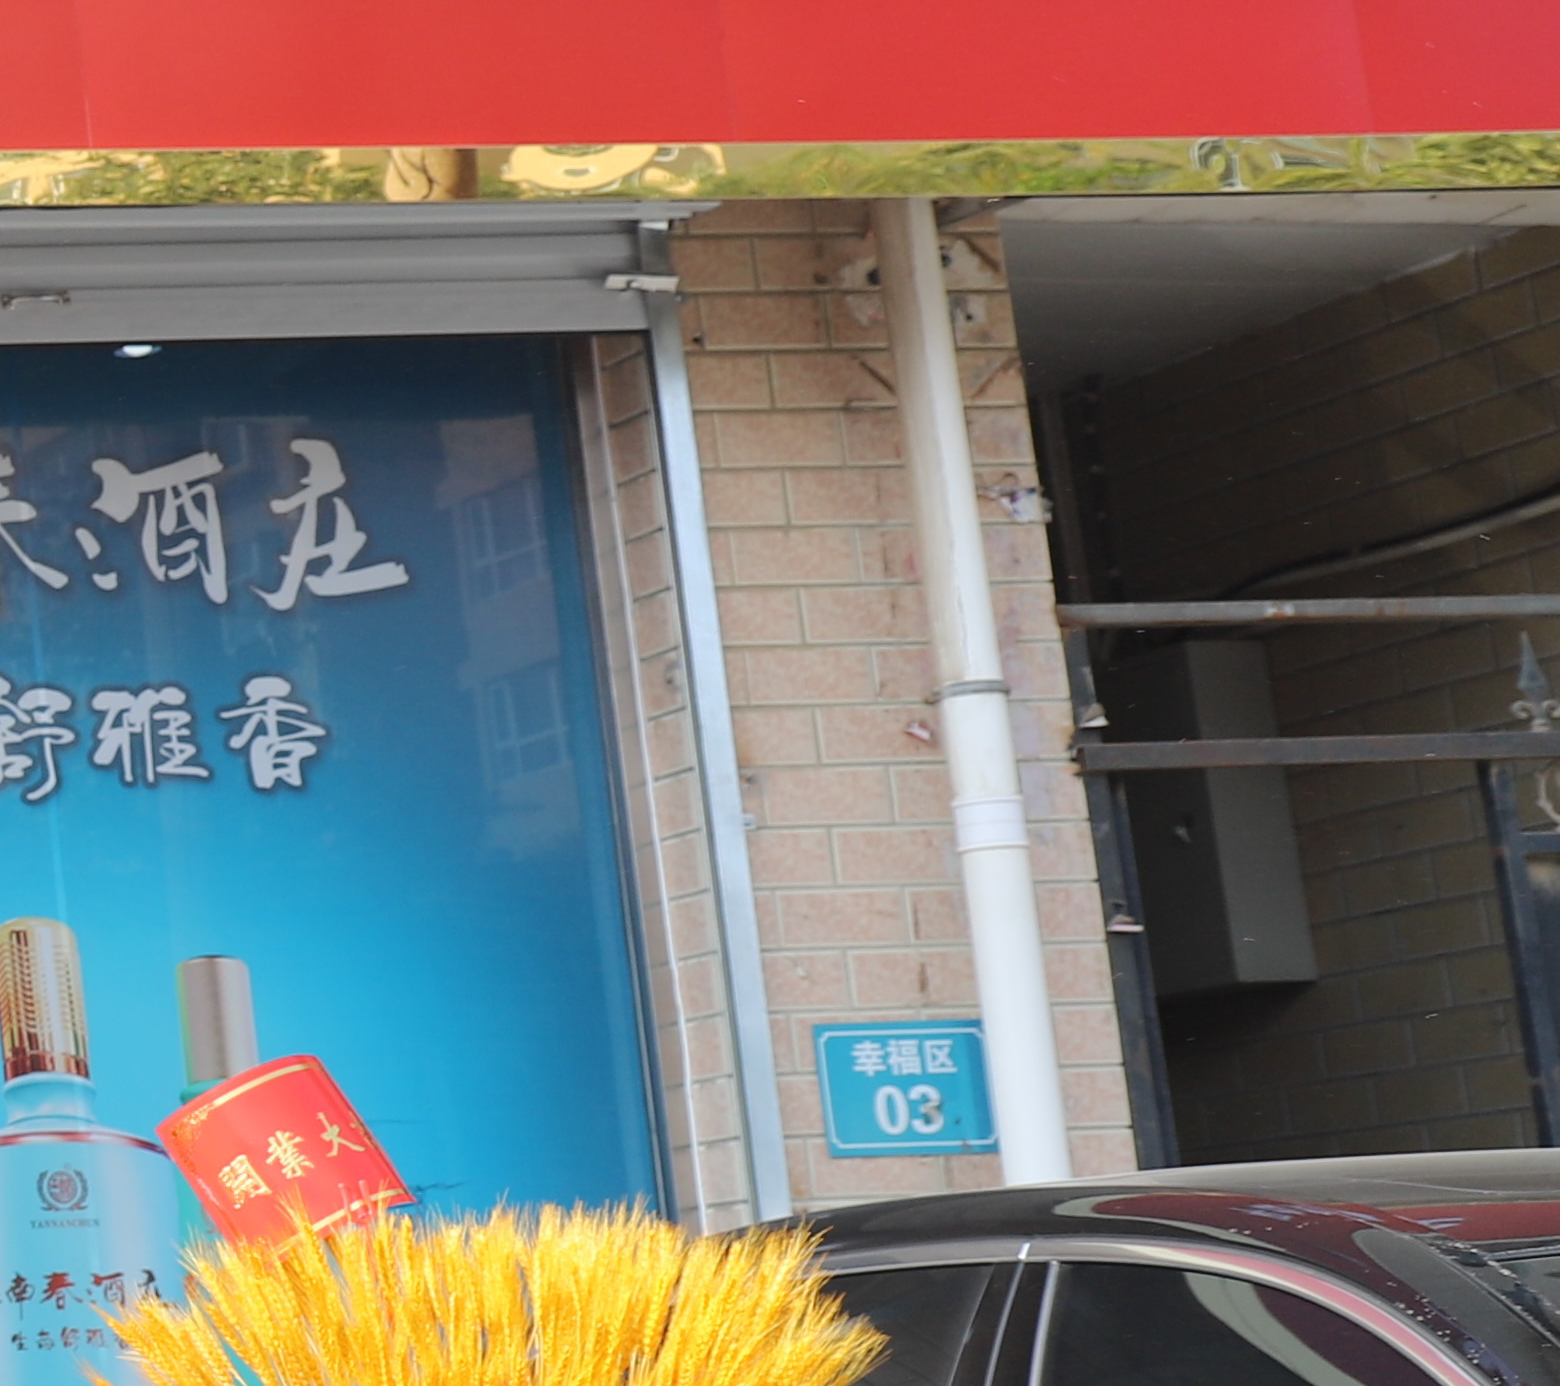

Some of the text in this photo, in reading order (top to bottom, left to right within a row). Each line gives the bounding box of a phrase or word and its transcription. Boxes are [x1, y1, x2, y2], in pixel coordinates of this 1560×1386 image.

[851, 1038, 958, 1076] 幸福区
[874, 1084, 945, 1135] 03
[217, 1110, 379, 1210] 開業大
